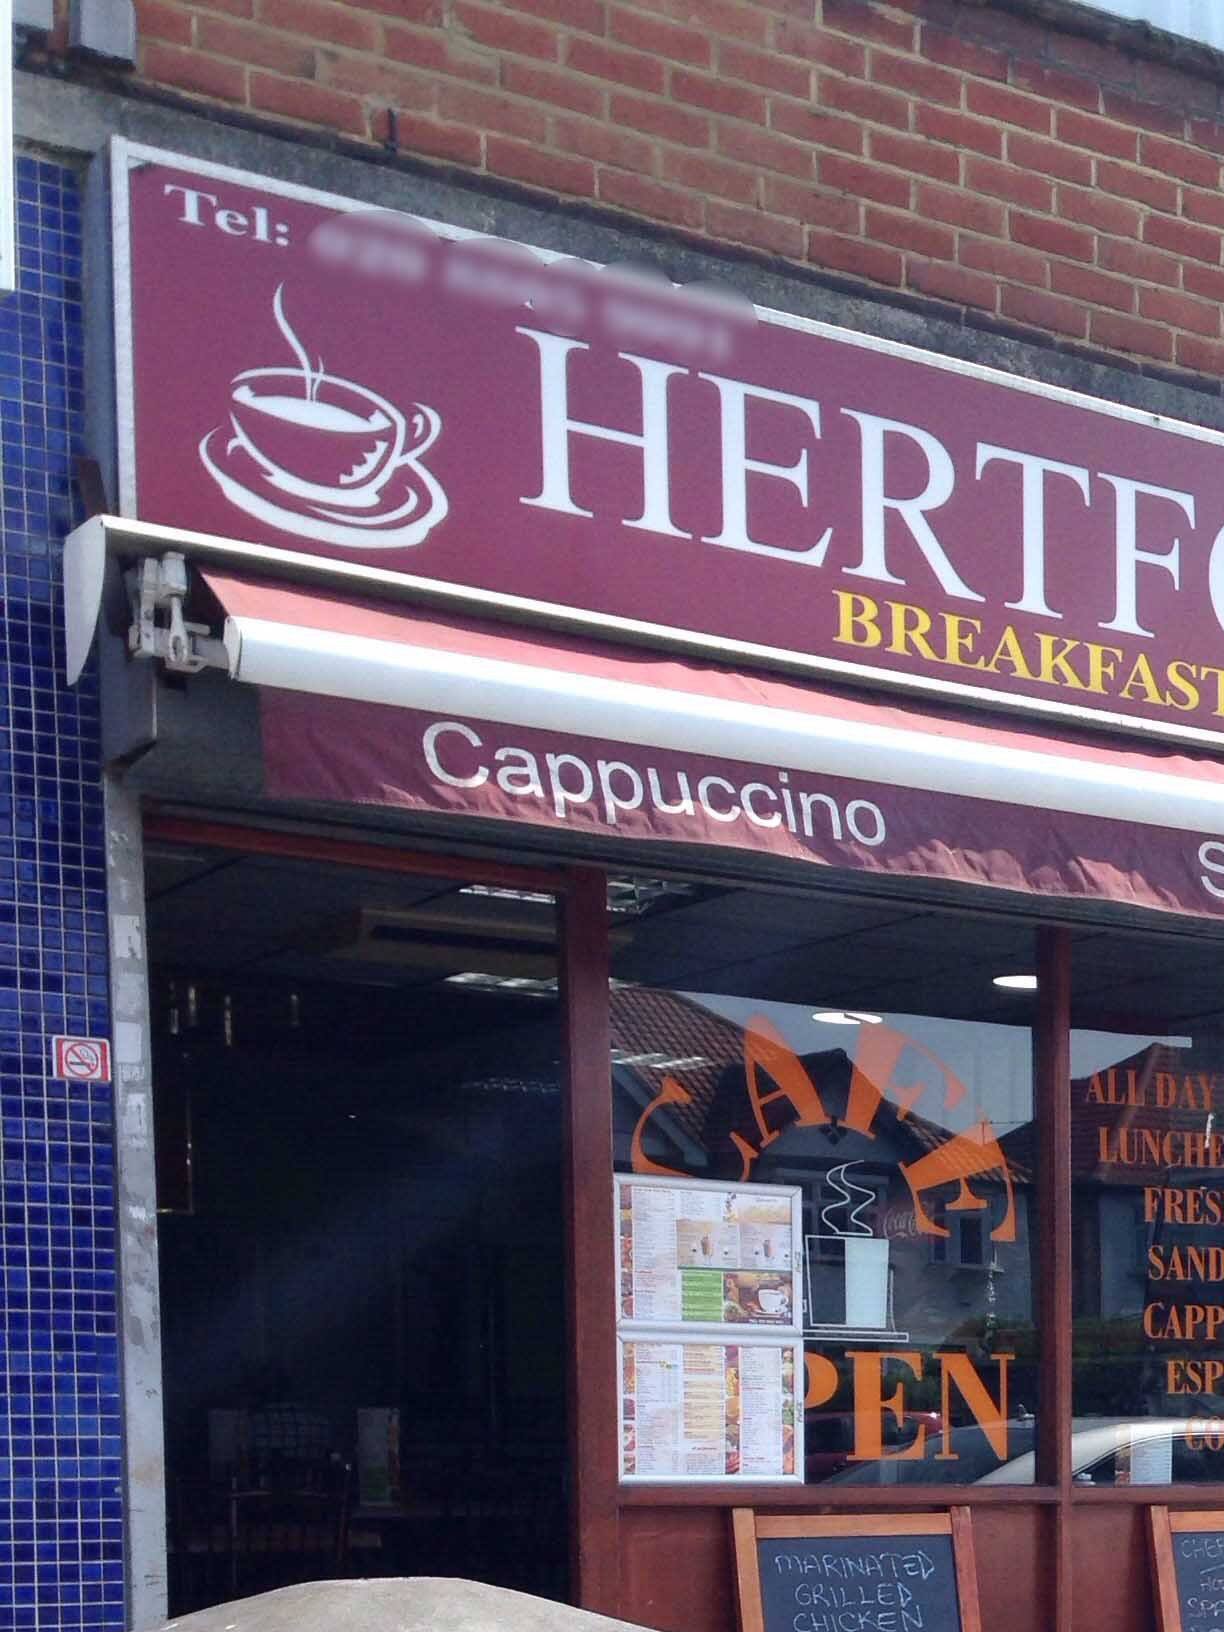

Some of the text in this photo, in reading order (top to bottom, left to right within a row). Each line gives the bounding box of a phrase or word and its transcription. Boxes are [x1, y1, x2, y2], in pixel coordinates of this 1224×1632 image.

[164, 182, 291, 247] Tel:
[421, 719, 888, 849] Cappuccino
[1086, 1068, 1146, 1107] ALL
[1156, 1072, 1217, 1112] DAY
[631, 1011, 1017, 1242] CAFE
[803, 1349, 1017, 1462] EN
[774, 1550, 936, 1580] MARINATED
[794, 1582, 914, 1608] GRILLED
